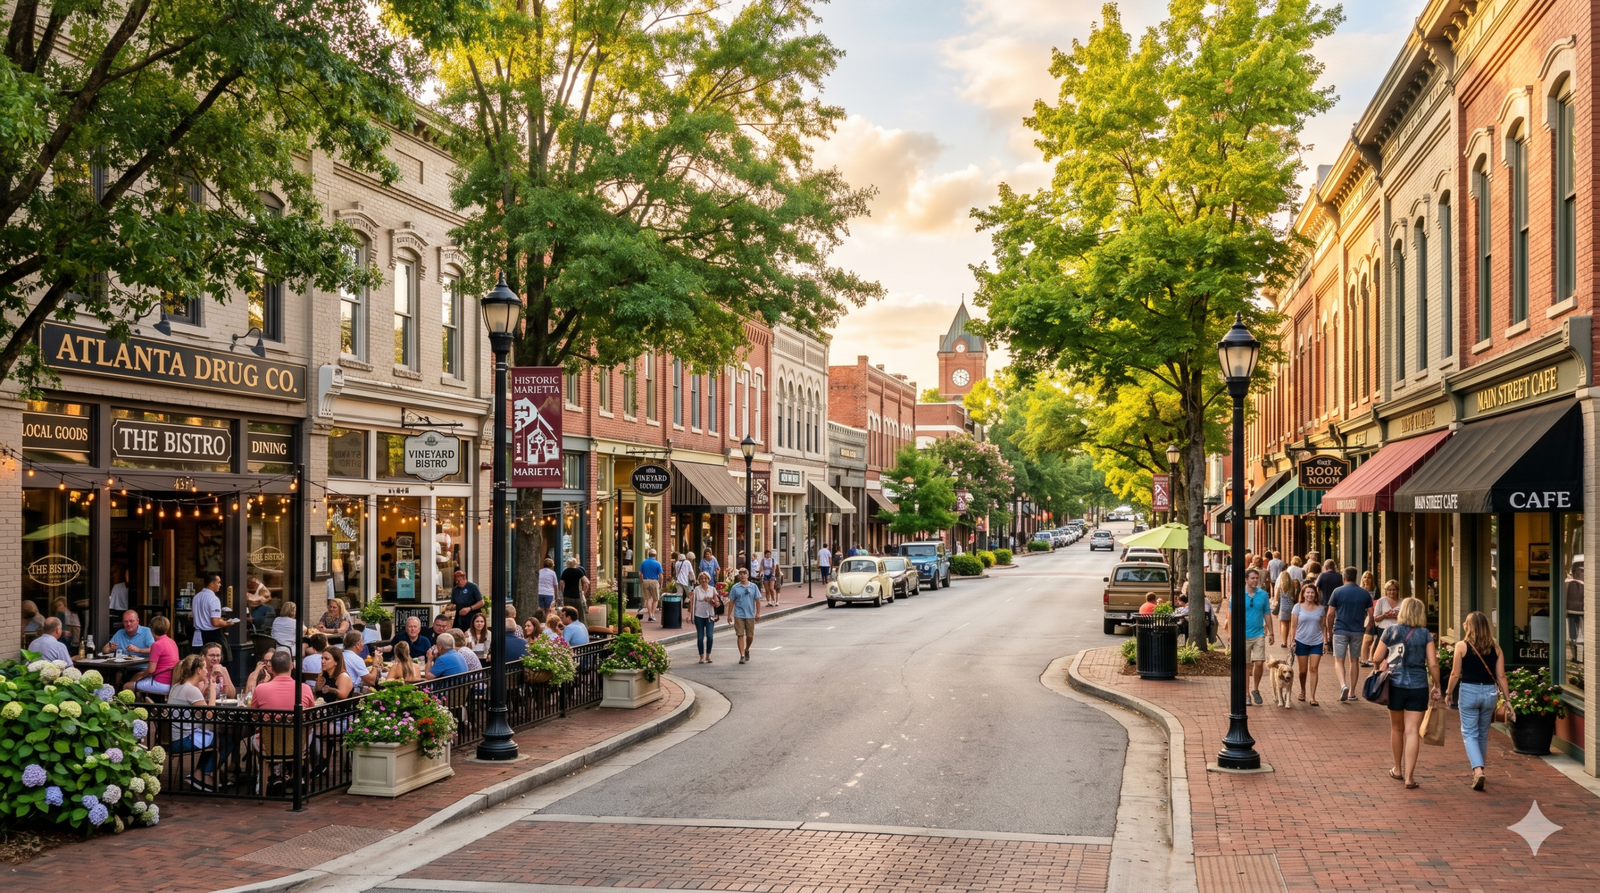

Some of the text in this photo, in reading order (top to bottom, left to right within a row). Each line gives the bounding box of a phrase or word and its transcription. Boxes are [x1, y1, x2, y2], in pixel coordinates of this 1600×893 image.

[56, 333, 298, 393] ATLANTA DRUG CO.
[514, 376, 559, 385] HISTORIC
[514, 385, 560, 394] MARIETTA
[1477, 366, 1558, 412] MAIN STREET CAFE
[22, 422, 88, 441] LOCAL GOODS
[120, 427, 226, 456] THE BISTRO
[251, 440, 287, 455] DINING
[408, 450, 455, 459] VINEYARD
[415, 459, 448, 468] BISTRO
[513, 467, 561, 476] MARIETTA
[1306, 466, 1343, 476] BOOK
[634, 474, 668, 482] VINEYARD
[1308, 476, 1340, 485] NOOM
[1414, 494, 1458, 509] MAIN STREET CAFE
[1509, 491, 1571, 509] CAFE
[31, 563, 79, 575] THE BISTRO
